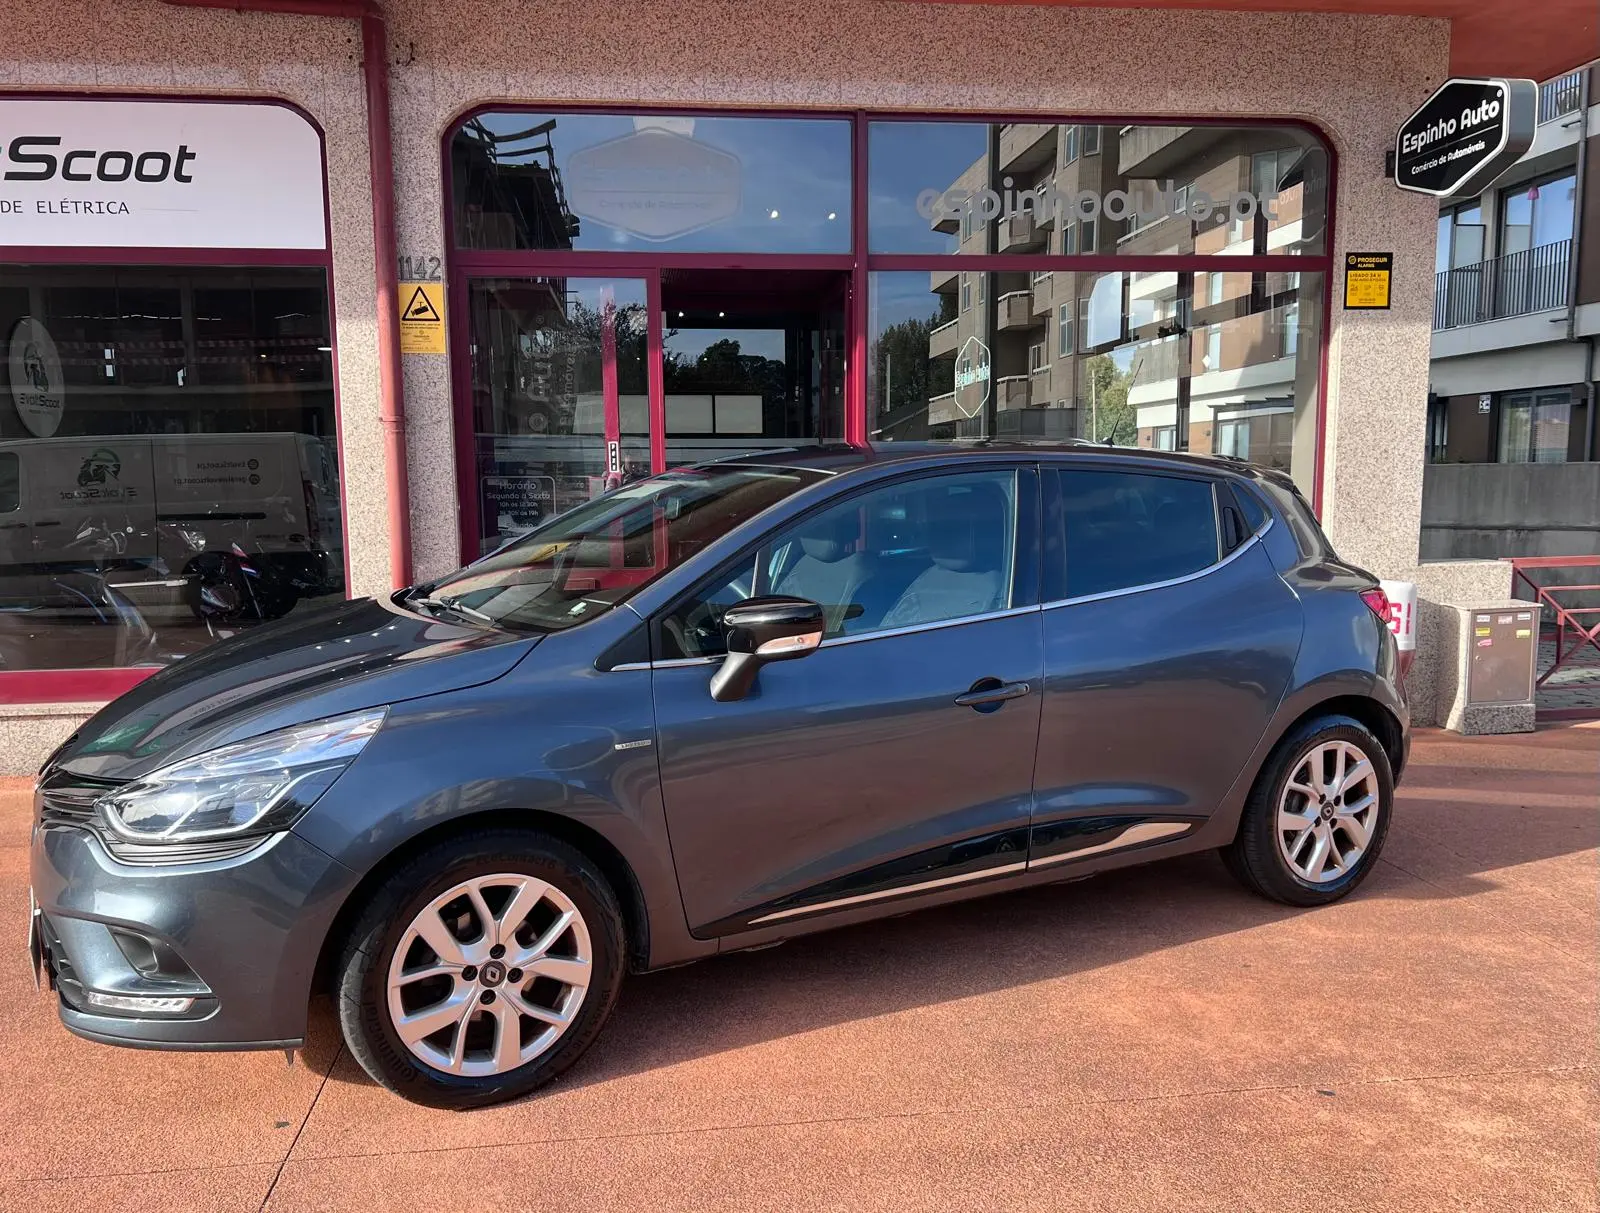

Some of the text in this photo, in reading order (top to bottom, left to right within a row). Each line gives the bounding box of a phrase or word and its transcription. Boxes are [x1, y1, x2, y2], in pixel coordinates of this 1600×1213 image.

[1402, 99, 1500, 154] Espinho Auto
[0, 136, 197, 183] Scoot
[1411, 140, 1486, 175] Comércio de Automóveis
[0, 198, 130, 214] DE ELÉTRICA
[916, 176, 1280, 232] espinhoauto.pt
[399, 255, 441, 281] 1142
